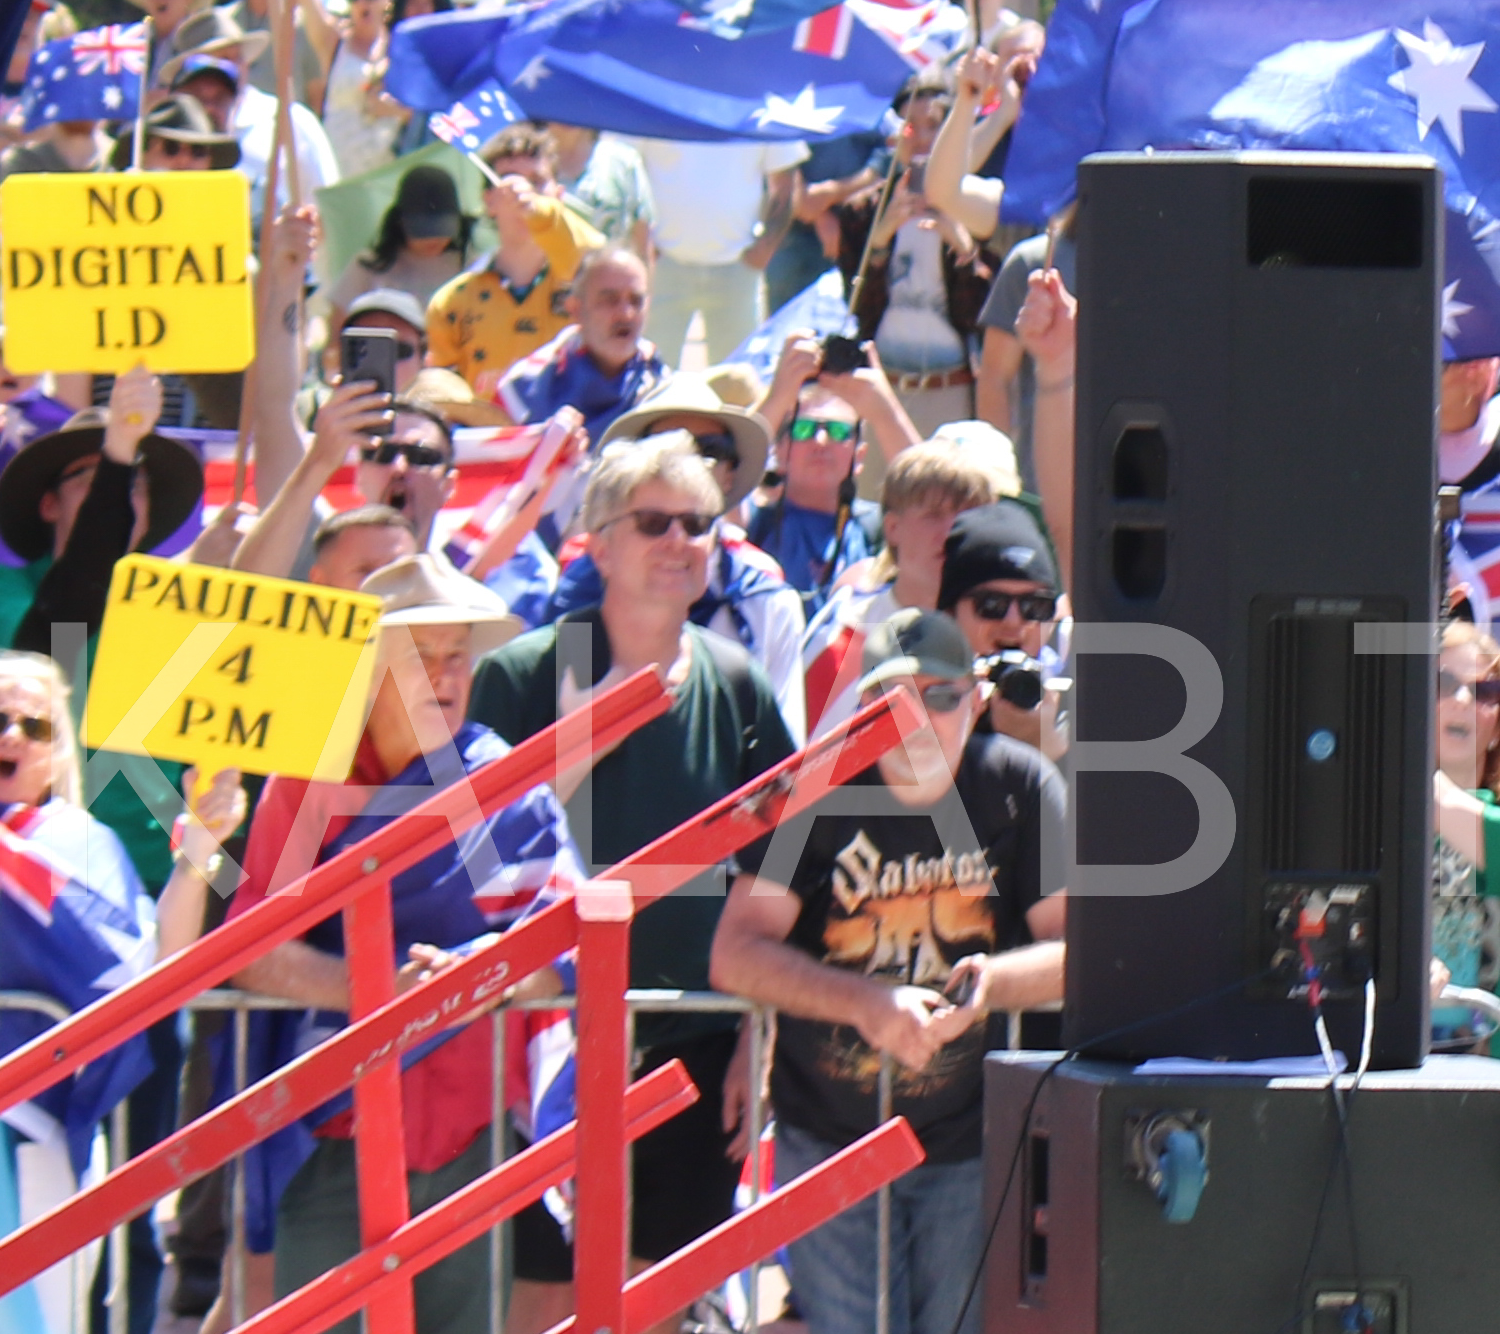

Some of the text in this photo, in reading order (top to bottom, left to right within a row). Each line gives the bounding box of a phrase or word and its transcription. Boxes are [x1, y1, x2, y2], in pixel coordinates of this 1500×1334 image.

[86, 184, 165, 227] NO
[7, 244, 248, 290] DIGITAL
[95, 305, 167, 350] I.D
[120, 565, 380, 645] PAULINE
[216, 643, 255, 686] 4
[175, 697, 272, 751] P.M
